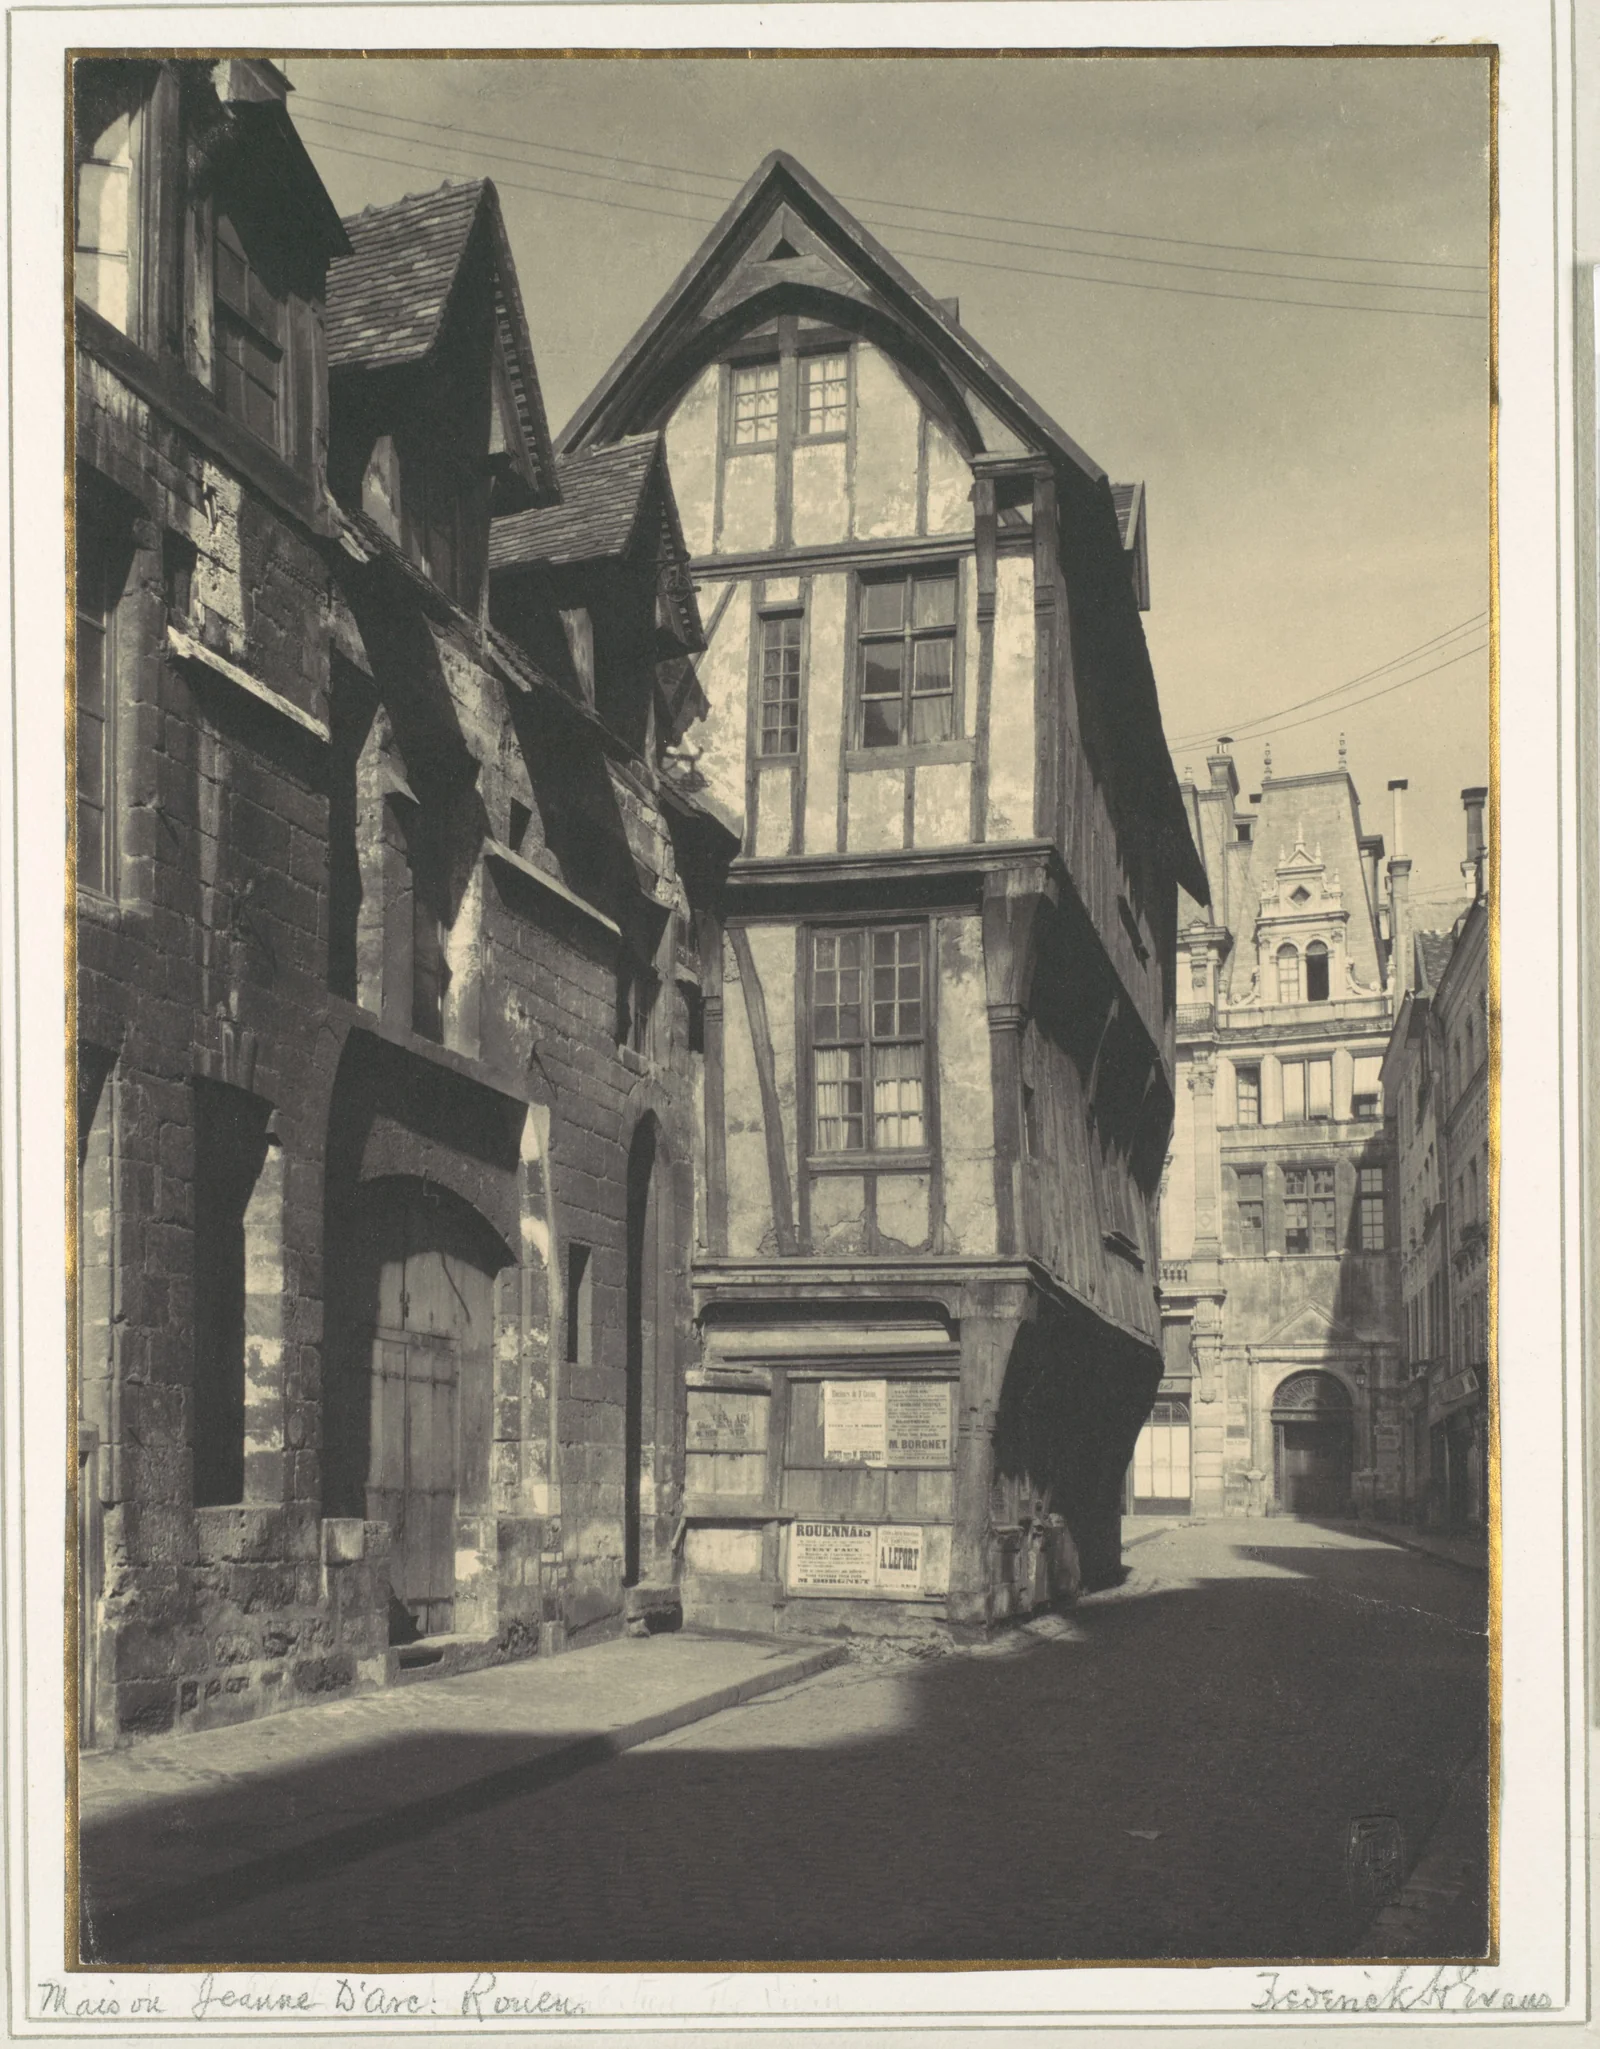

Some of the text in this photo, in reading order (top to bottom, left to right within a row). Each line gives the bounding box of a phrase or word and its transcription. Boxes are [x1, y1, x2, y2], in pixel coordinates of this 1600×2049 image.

[901, 1439, 947, 1449] BORGNET
[796, 1524, 871, 1537] ROUENNAIS
[888, 1547, 919, 1571] LEFORT
[38, 1979, 167, 2016] Maison
[191, 1973, 325, 2020] Jeanne
[1456, 1966, 1552, 2010] Evans
